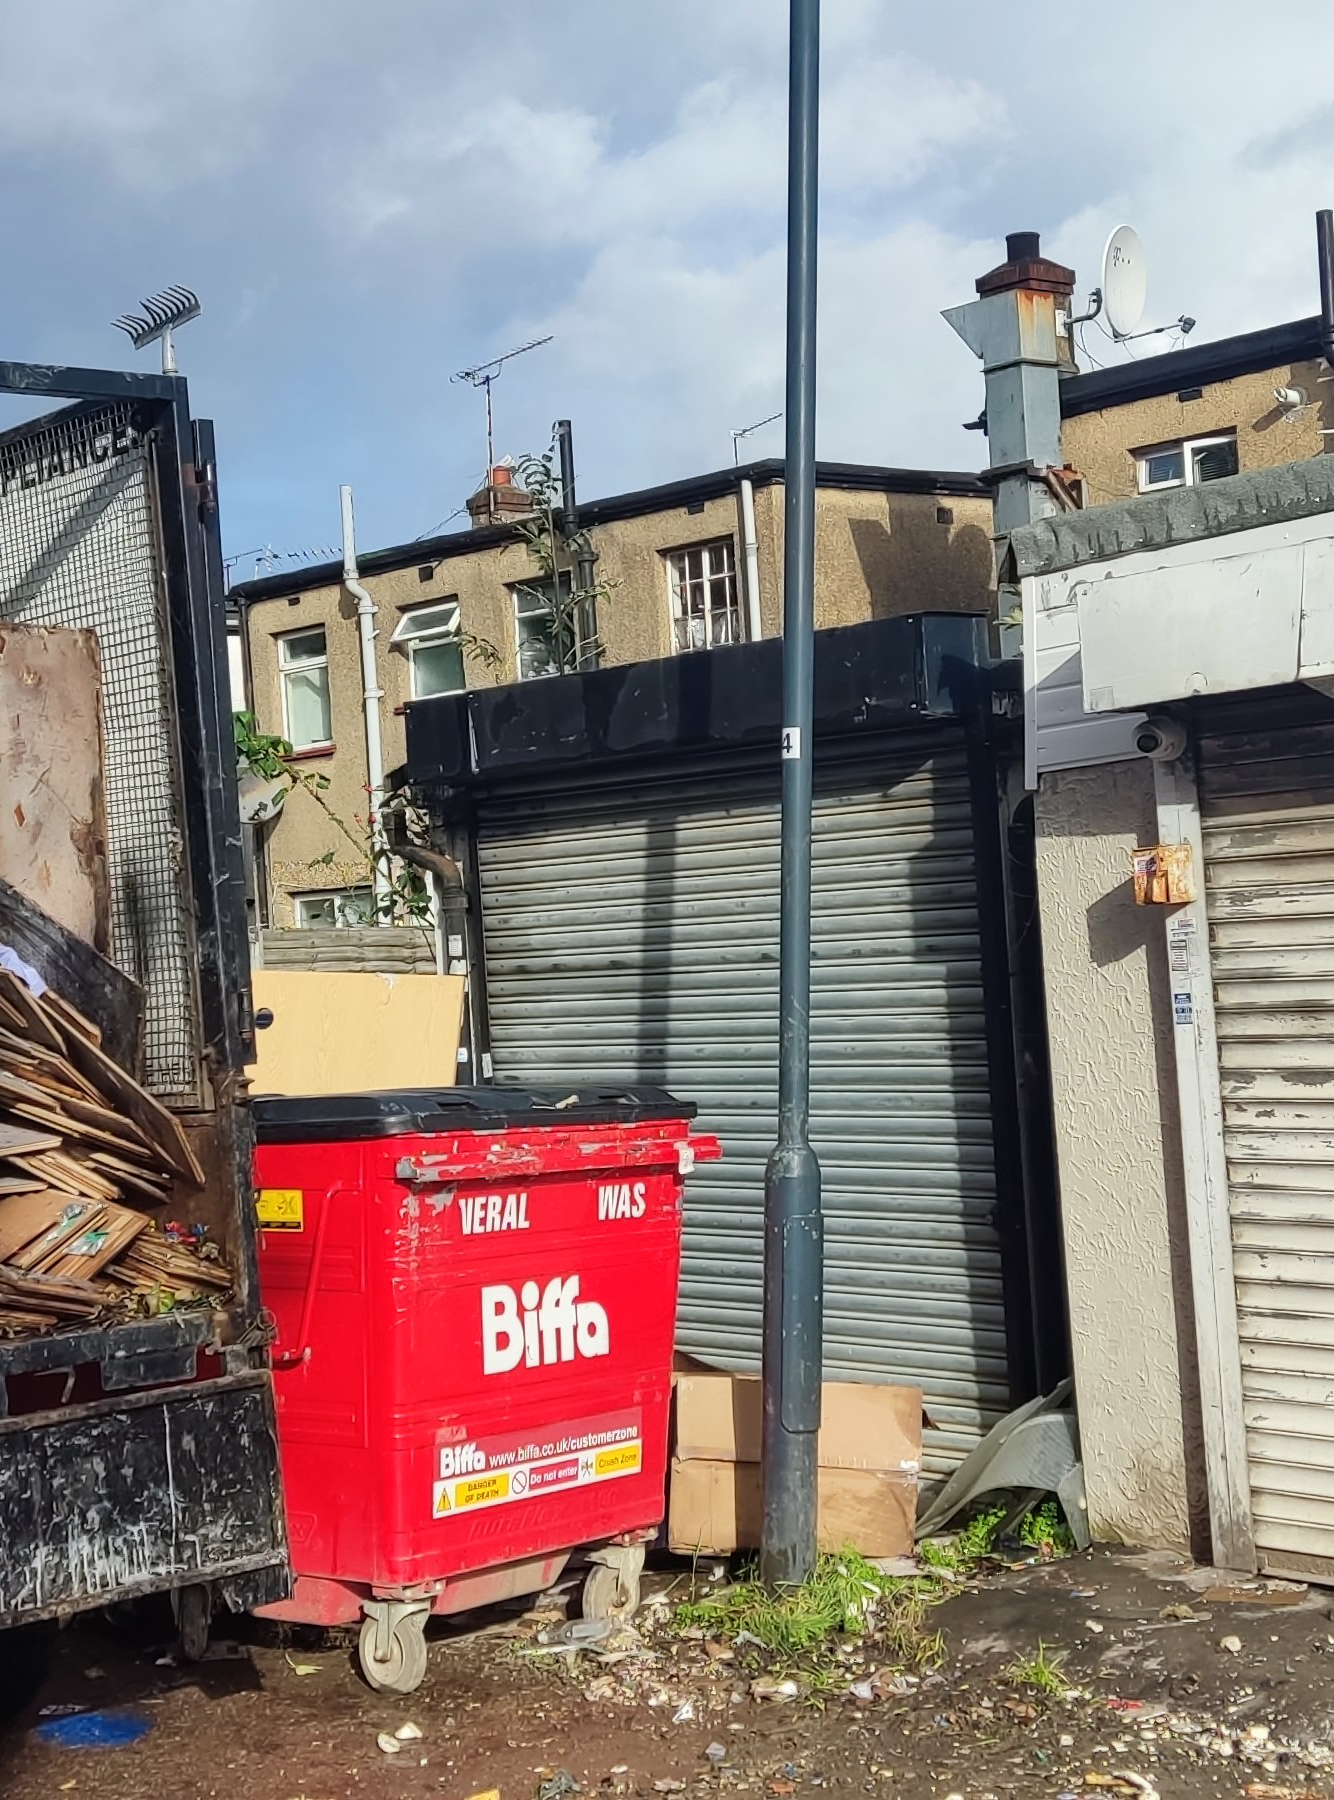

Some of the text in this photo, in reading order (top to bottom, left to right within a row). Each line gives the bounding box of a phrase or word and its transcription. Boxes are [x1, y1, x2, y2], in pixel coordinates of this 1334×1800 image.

[481, 1274, 610, 1375] Biffa
[439, 1425, 638, 1479] Biffa www.biffa.co.uk/customerzone
[530, 1466, 578, 1485] Do not enter
